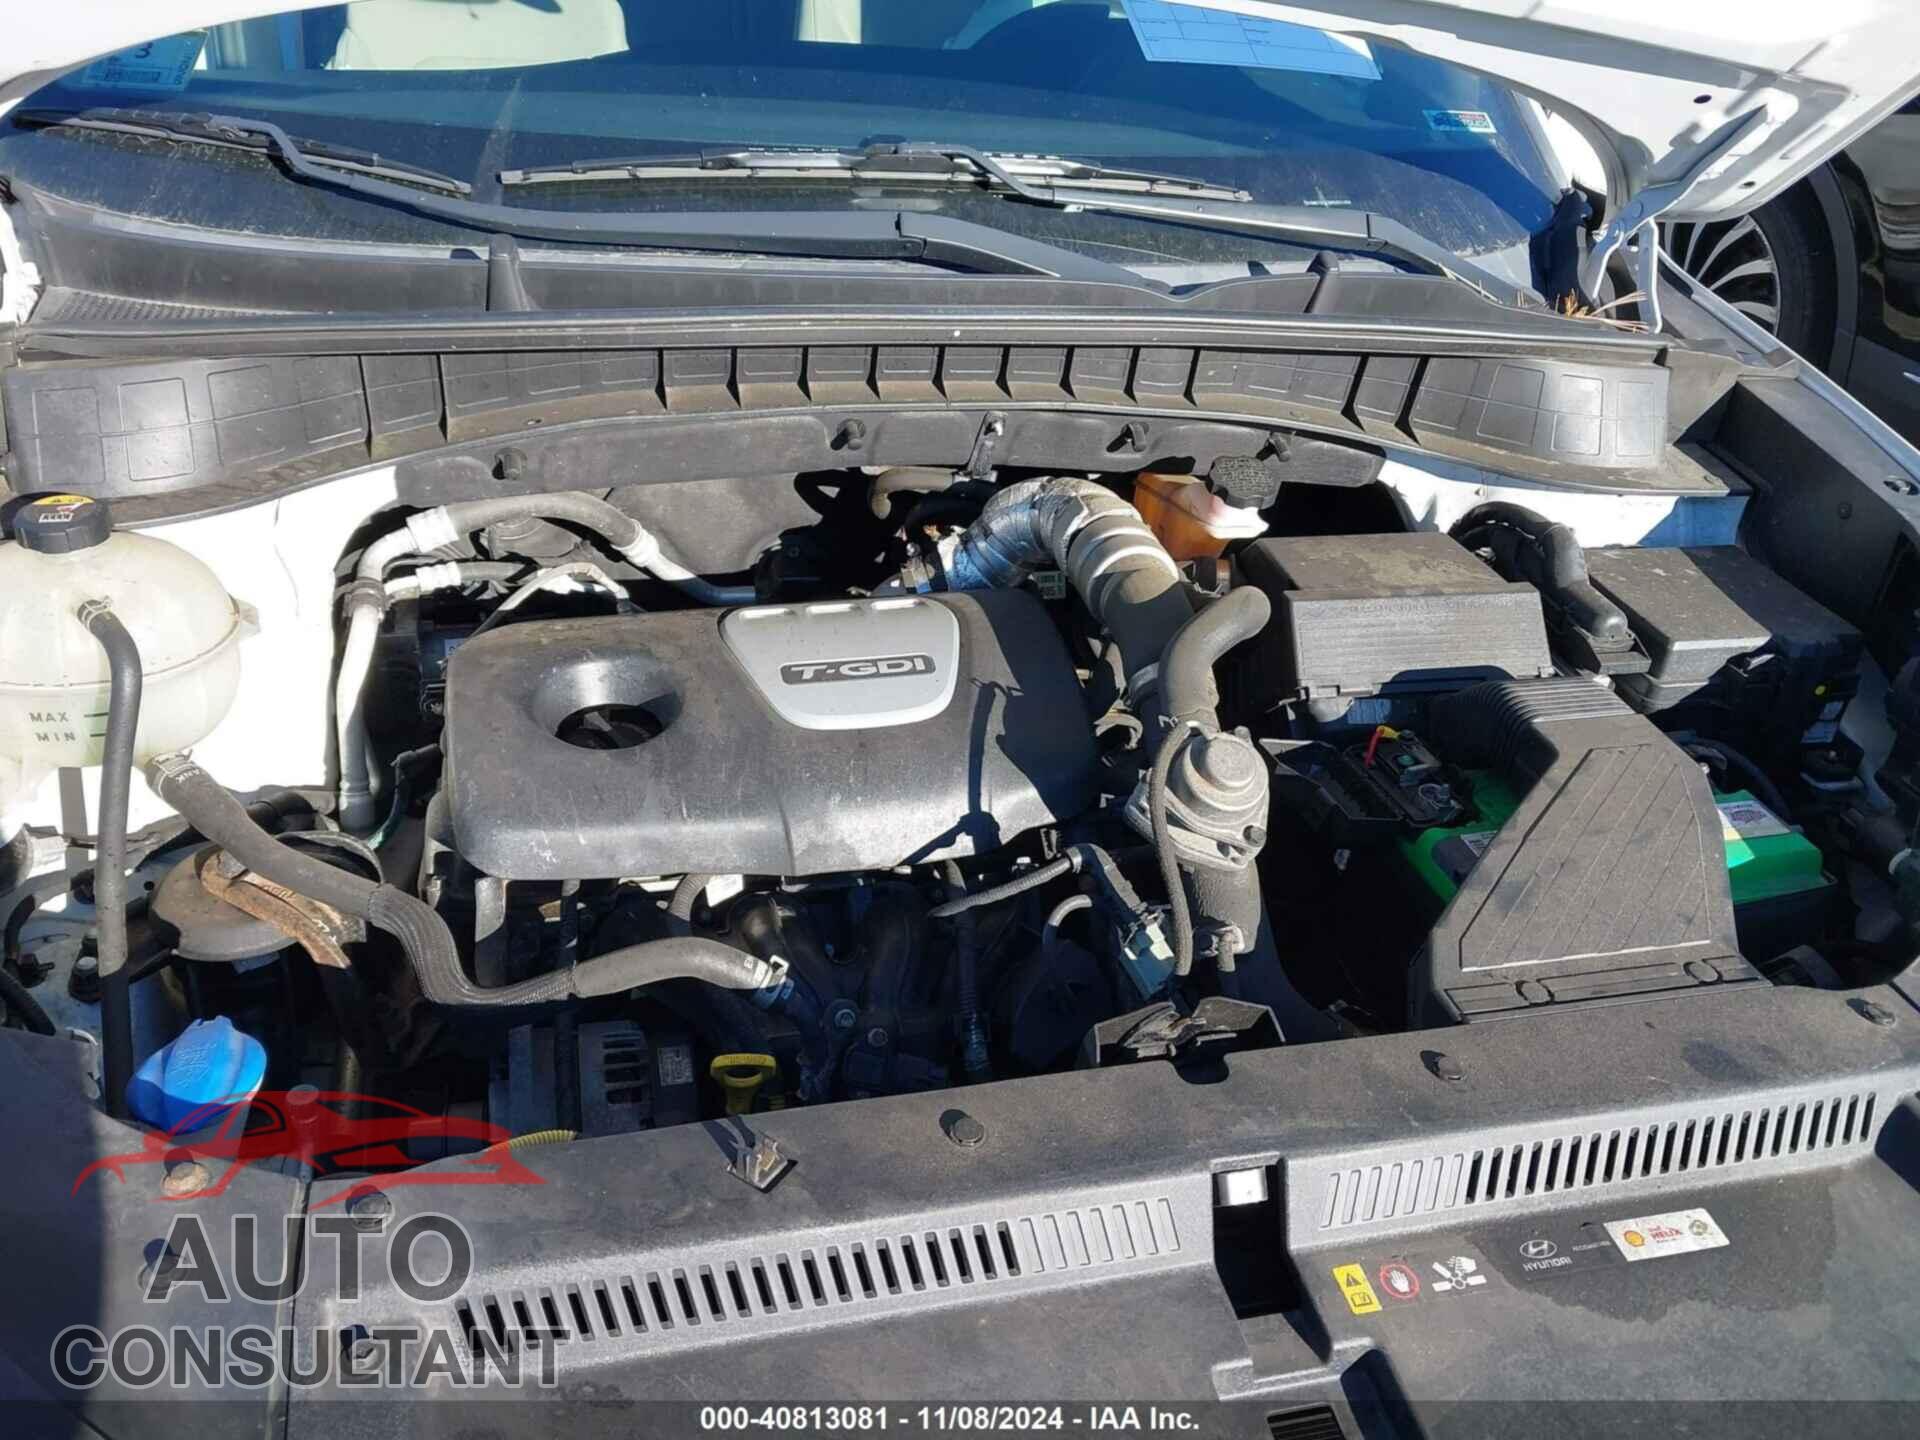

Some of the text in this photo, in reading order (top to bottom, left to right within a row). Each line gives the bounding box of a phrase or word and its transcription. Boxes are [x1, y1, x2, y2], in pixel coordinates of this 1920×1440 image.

[791, 657, 926, 680] T-GDI
[29, 711, 68, 722] MAX
[35, 731, 76, 742] MIN
[1523, 1256, 1573, 1271] HYUNDAI
